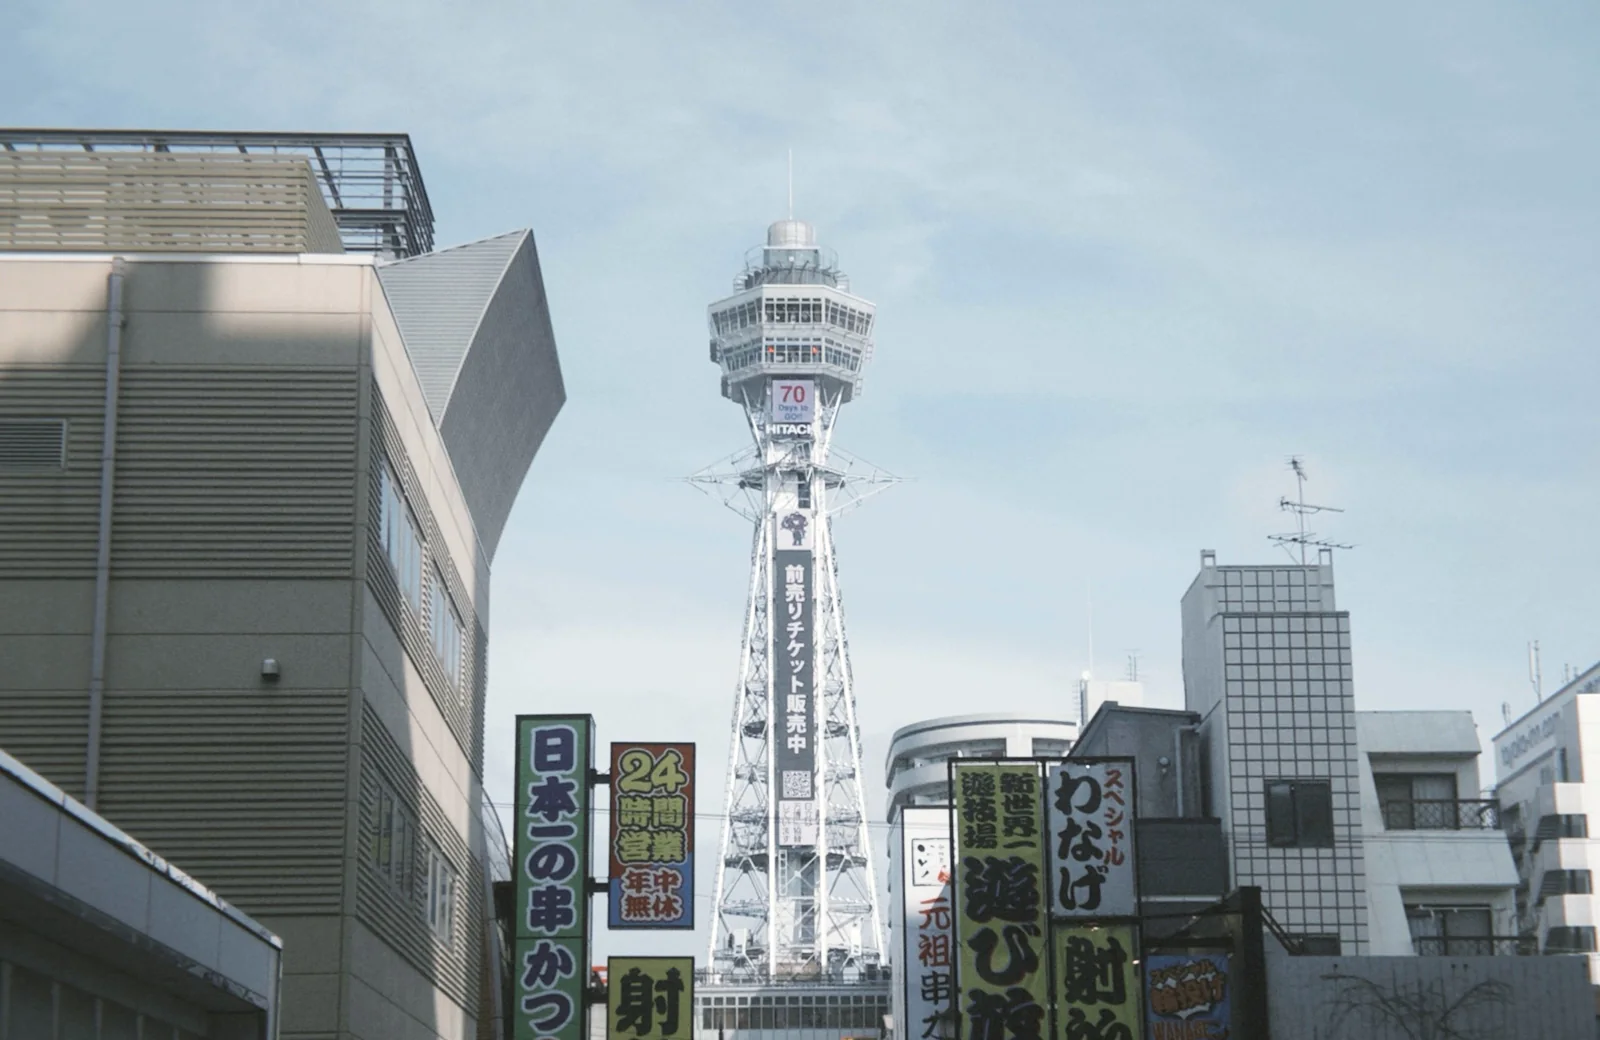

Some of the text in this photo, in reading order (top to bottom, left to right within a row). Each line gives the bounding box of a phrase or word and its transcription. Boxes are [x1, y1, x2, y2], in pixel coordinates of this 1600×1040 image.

[780, 385, 805, 403] 70
[765, 424, 814, 434] HITACH
[784, 564, 807, 754] 前売りチケット販売中
[617, 749, 688, 795] 24
[618, 795, 686, 828] 時間
[1104, 770, 1125, 866] スペシャル
[615, 829, 686, 864] 営業
[1054, 771, 1109, 910] わなげ
[521, 725, 579, 1035] 日本一の串かつ
[622, 868, 682, 896] 年中
[622, 895, 682, 921] 無休
[615, 967, 685, 1040] 射
